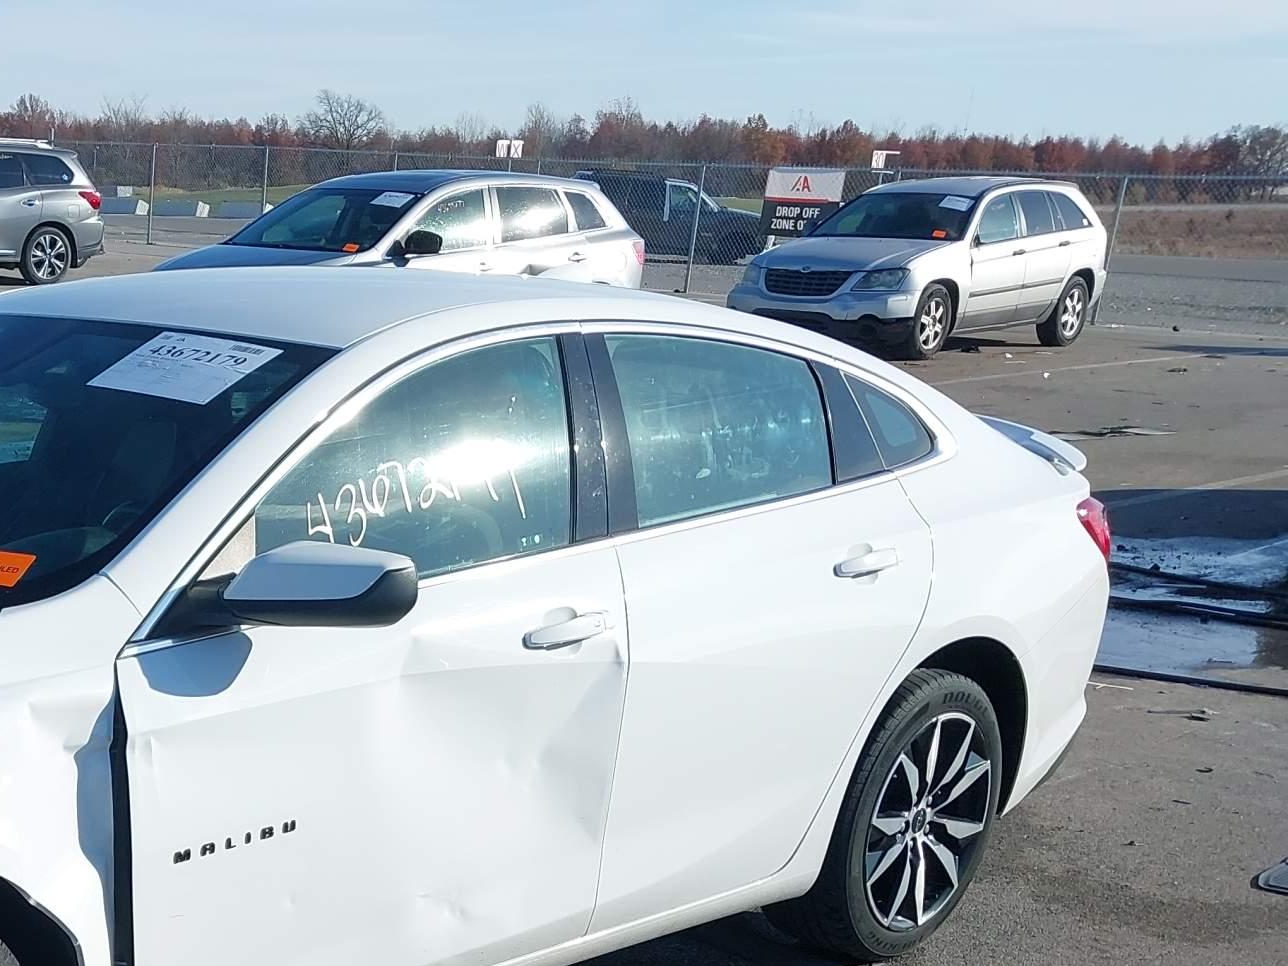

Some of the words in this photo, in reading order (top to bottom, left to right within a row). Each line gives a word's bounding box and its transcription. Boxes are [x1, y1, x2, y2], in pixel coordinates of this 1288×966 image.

[497, 142, 509, 158] W
[512, 142, 521, 158] X
[775, 206, 801, 218] DROP
[802, 207, 821, 219] OFF
[770, 218, 795, 230] ZONE
[149, 344, 248, 367] 43672179
[172, 819, 297, 865] MALIBU
